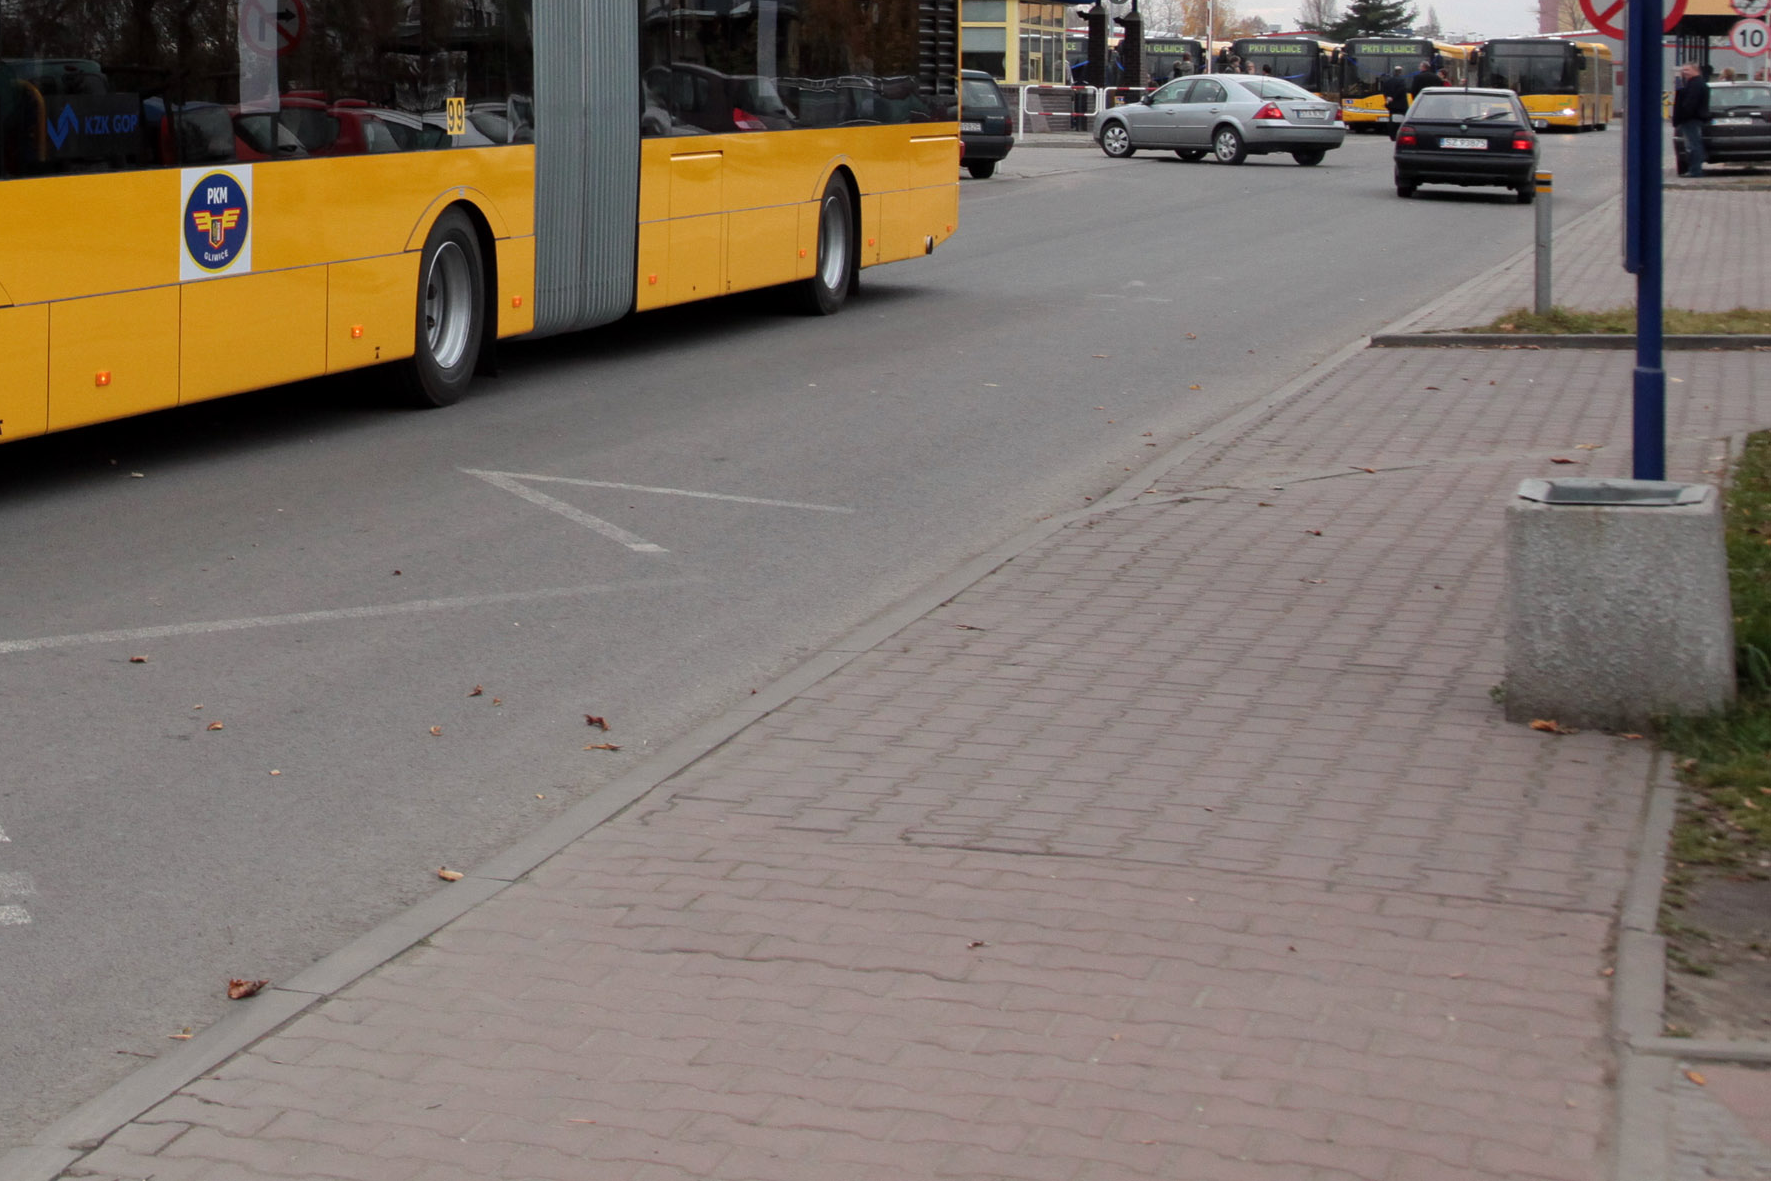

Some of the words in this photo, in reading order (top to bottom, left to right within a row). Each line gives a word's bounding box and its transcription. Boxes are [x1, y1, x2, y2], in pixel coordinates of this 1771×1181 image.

[1739, 29, 1765, 48] 10
[84, 115, 110, 134] KZK
[113, 114, 139, 133] GOP
[448, 99, 464, 132] 99
[207, 186, 228, 205] PKM
[203, 249, 229, 262] GLIWICE
